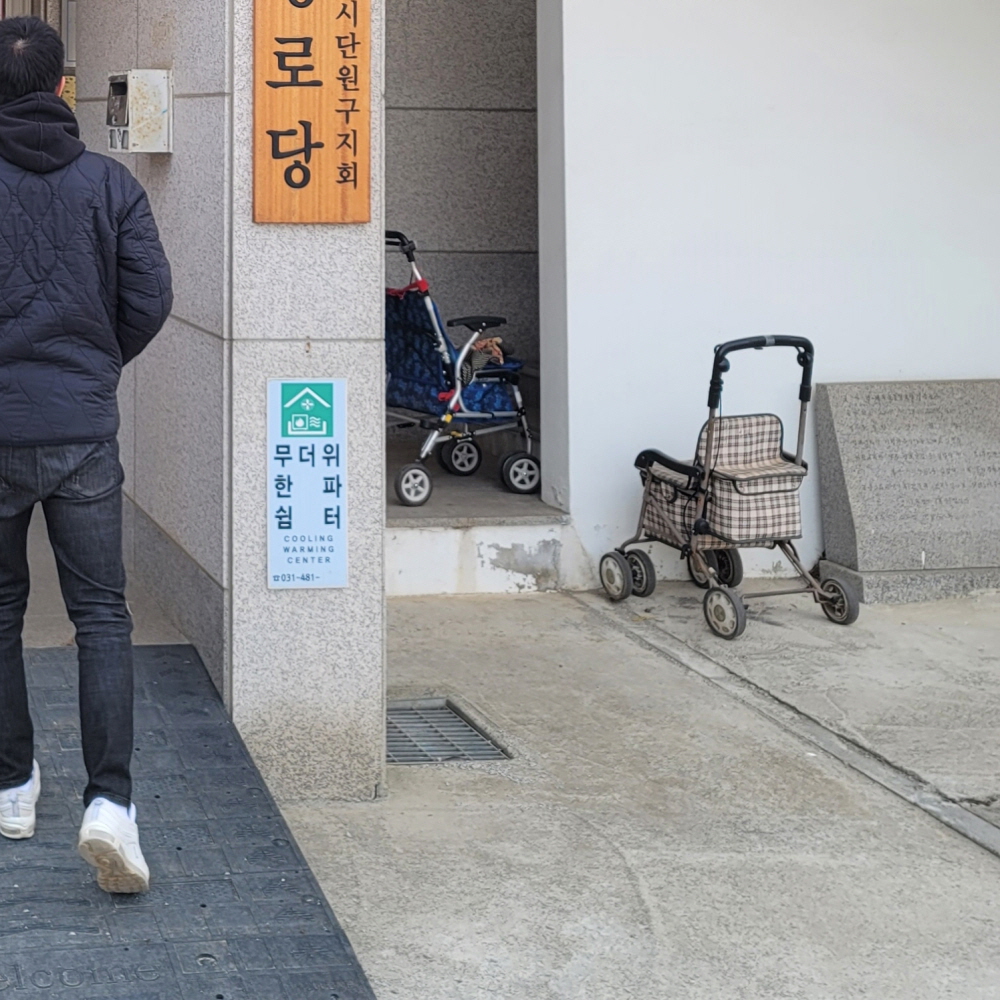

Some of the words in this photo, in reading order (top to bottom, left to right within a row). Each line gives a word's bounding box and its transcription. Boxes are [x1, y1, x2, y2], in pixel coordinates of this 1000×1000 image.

[273, 443, 340, 468] 무더위
[283, 535, 334, 543] COOLING
[283, 545, 335, 553] WARMING
[287, 556, 332, 564] CENTER
